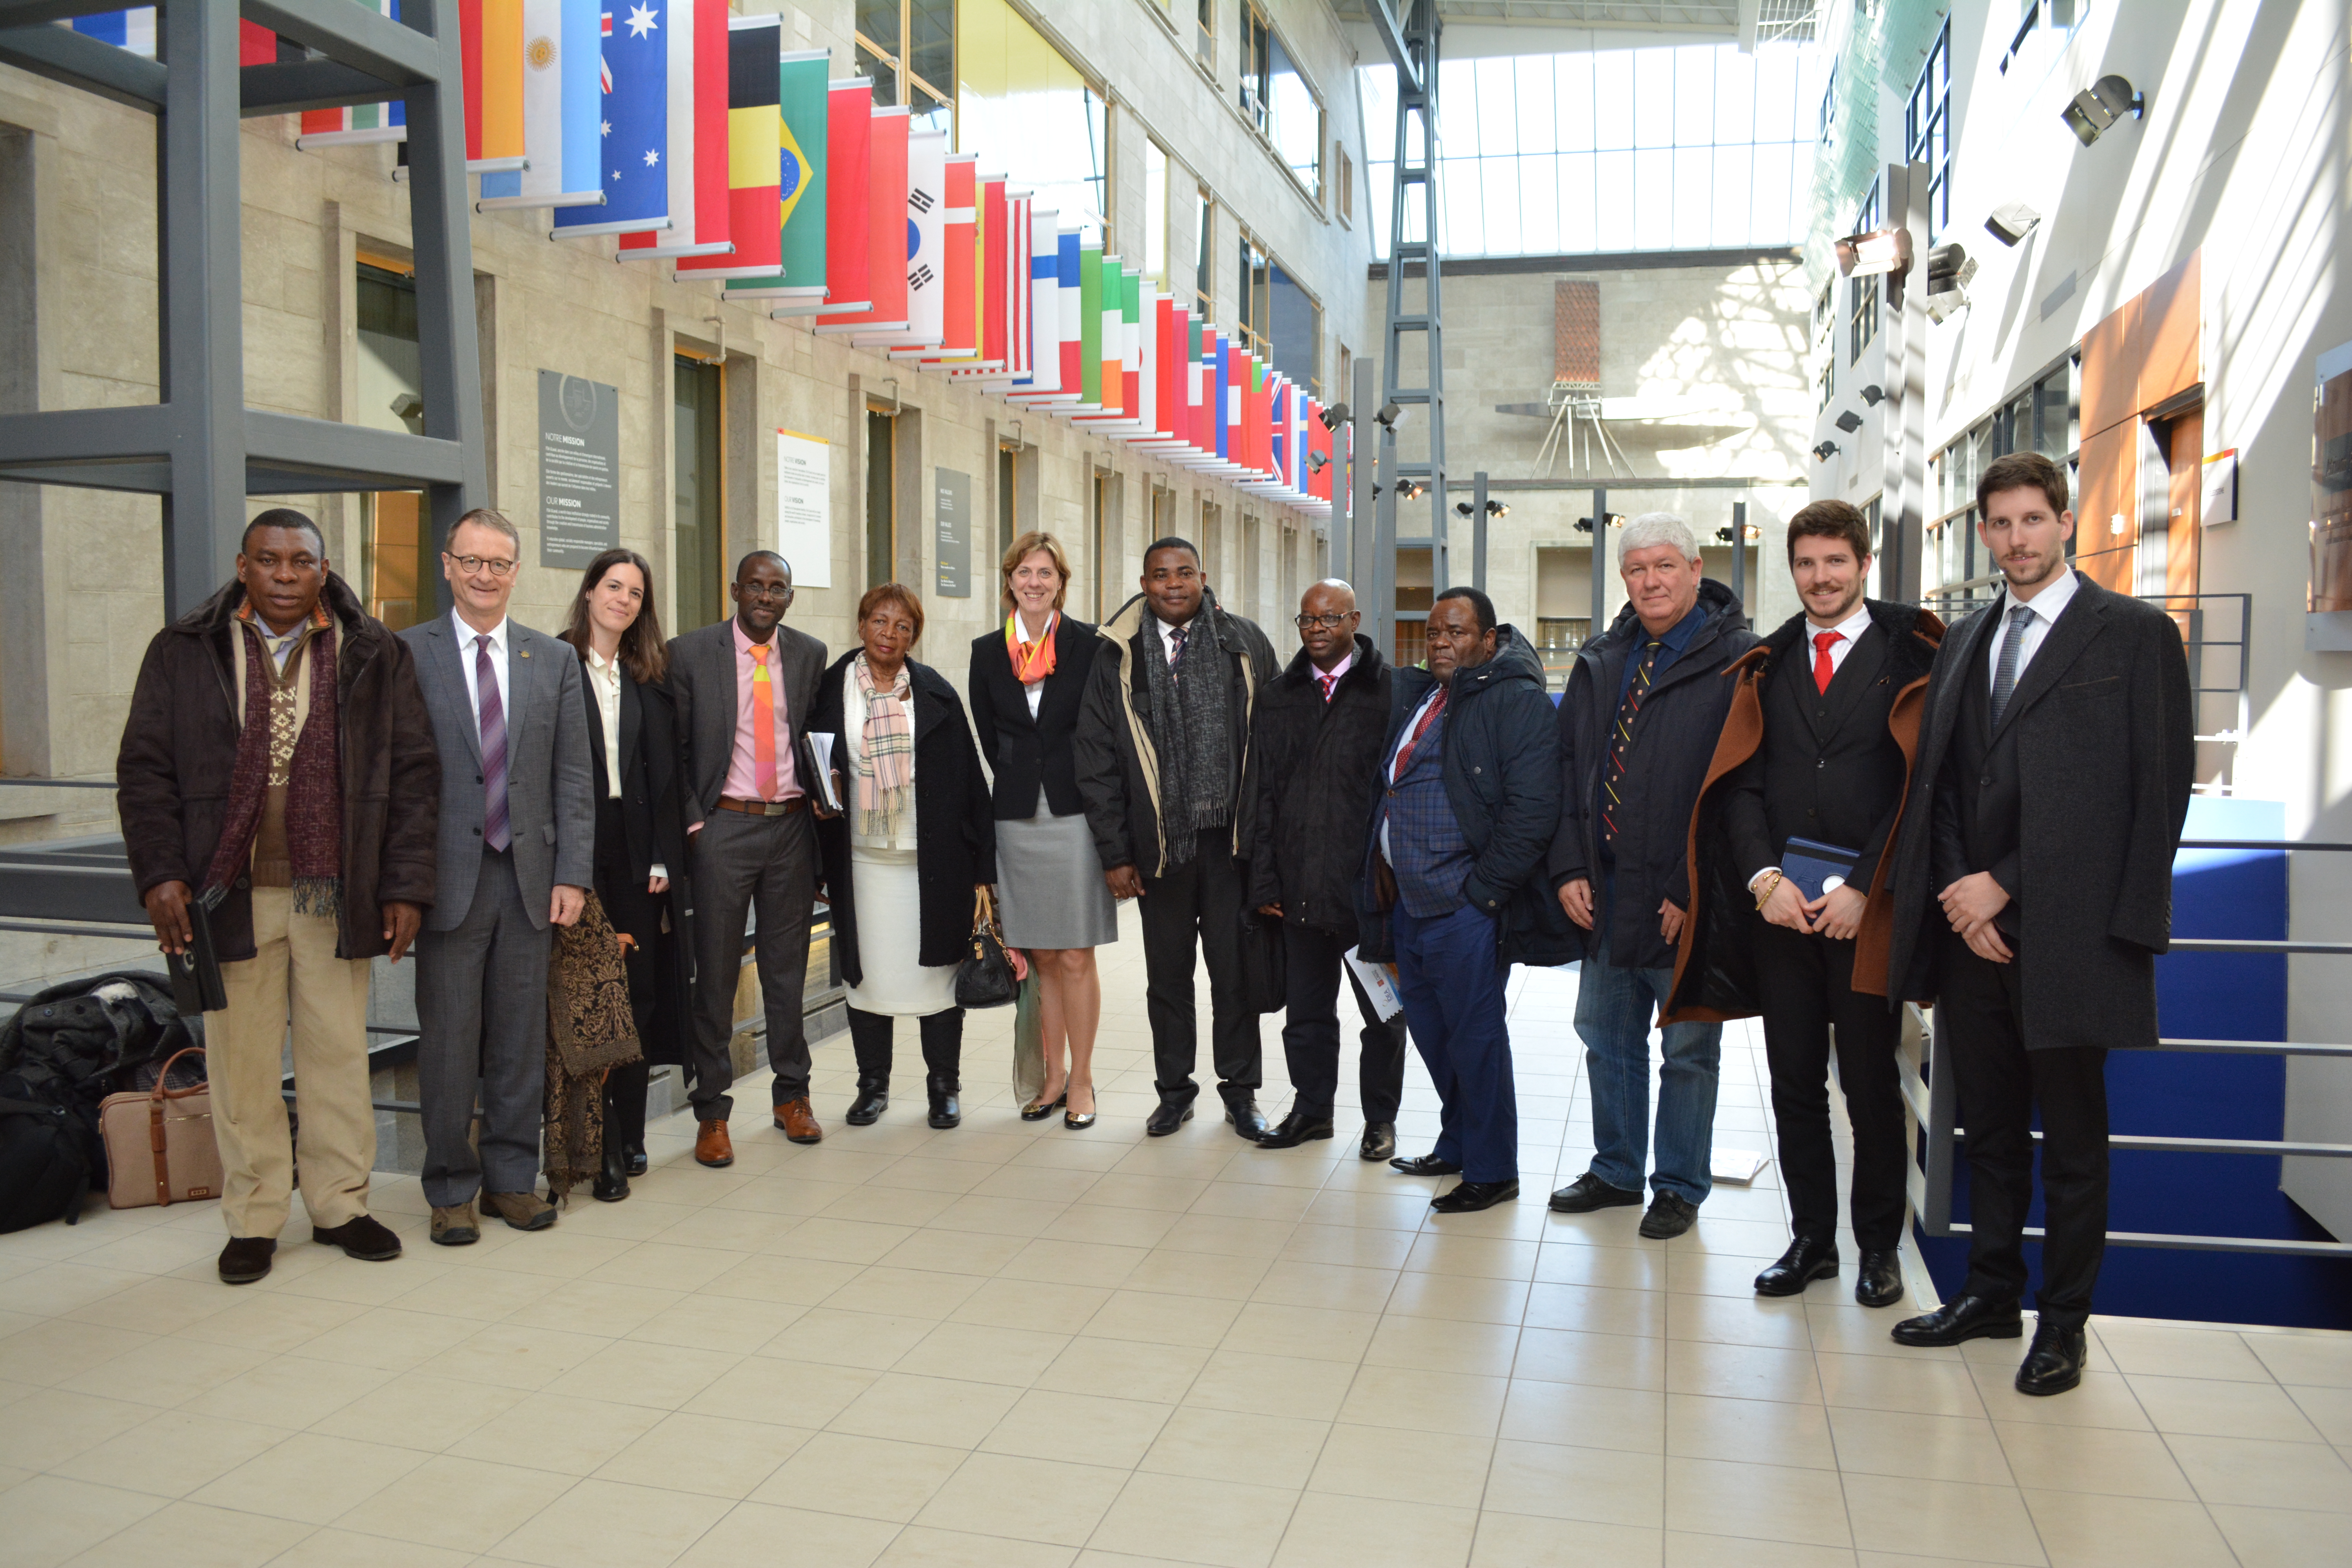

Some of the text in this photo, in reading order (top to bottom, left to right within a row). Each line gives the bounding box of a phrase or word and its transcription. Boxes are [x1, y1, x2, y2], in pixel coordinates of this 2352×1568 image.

[545, 432, 584, 446] NOTRE MISSION
[546, 496, 581, 508] OUR MISSION
